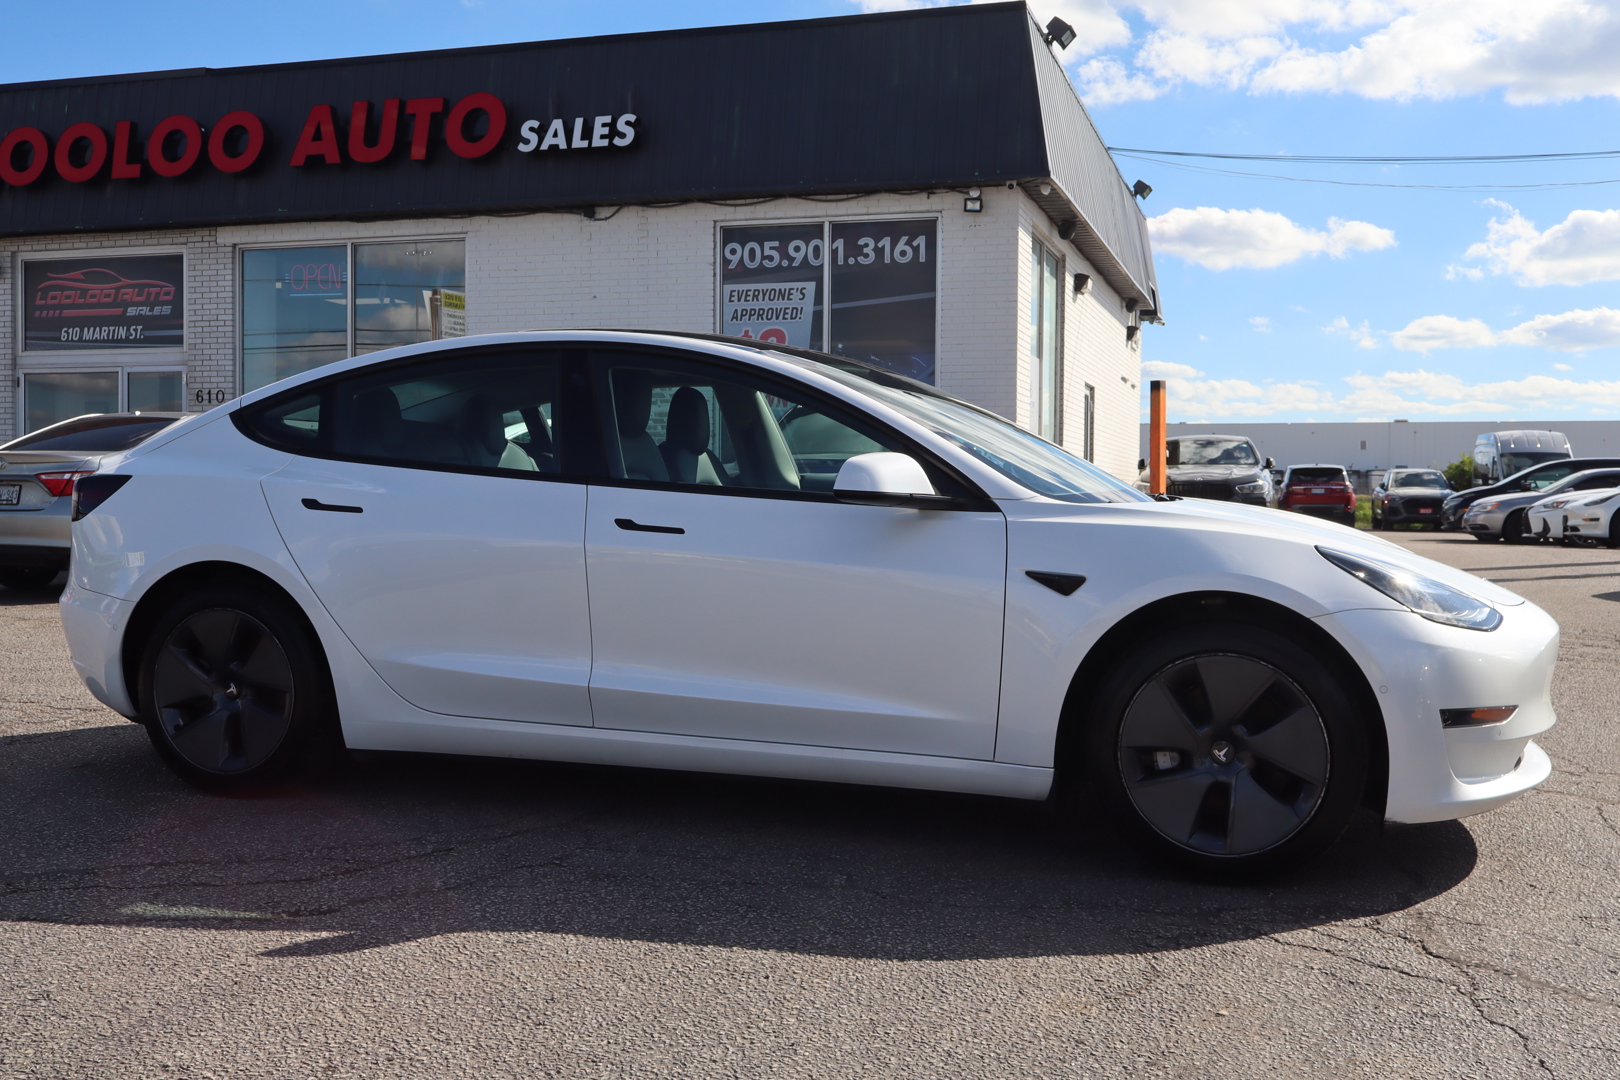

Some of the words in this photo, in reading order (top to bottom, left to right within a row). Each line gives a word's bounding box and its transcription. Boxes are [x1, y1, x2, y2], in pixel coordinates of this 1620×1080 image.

[289, 92, 507, 167] AUTO
[517, 113, 637, 153] SALES
[724, 235, 926, 269] 905.901.3161
[290, 263, 341, 290] OPEN
[35, 289, 116, 305] LOOLOO
[117, 287, 176, 302] AUTO
[728, 287, 807, 303] EVERYONE'S
[126, 305, 172, 316] SALES
[730, 306, 804, 322] APPROVED!
[60, 327, 80, 341] 610
[82, 326, 127, 341] MARTIN
[128, 325, 144, 339] ST.
[195, 389, 225, 404] 610
